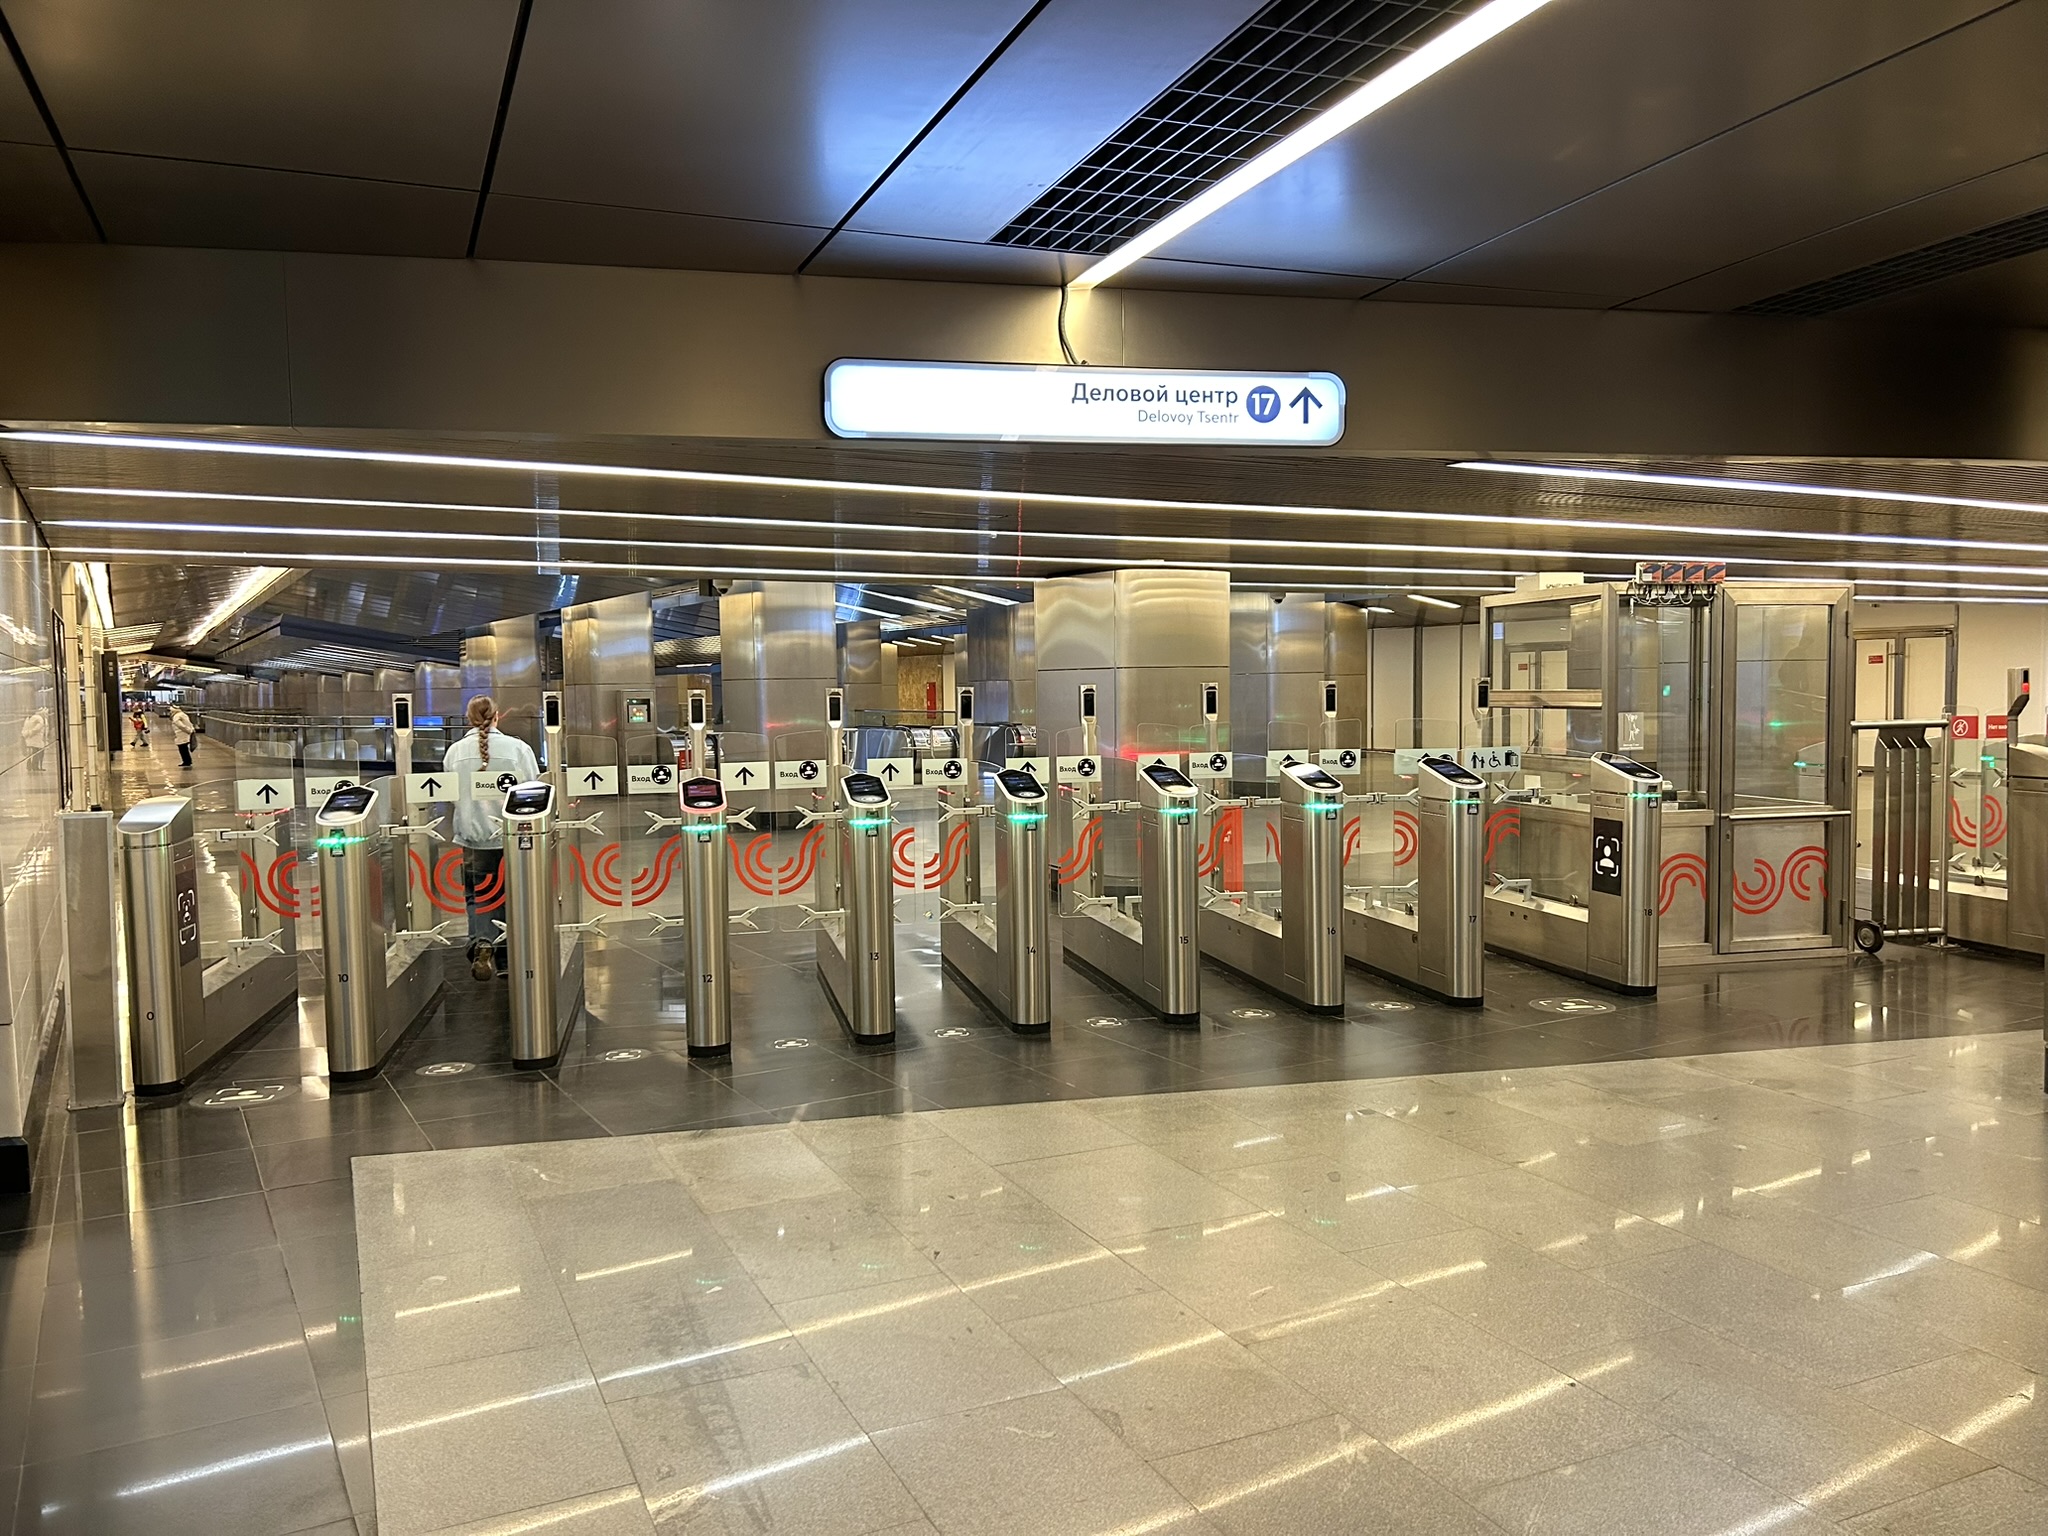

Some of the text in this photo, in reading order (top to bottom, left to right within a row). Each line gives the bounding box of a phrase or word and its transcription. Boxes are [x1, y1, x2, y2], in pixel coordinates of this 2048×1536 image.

[1072, 383, 1238, 408] Деловой центр
[1251, 393, 1276, 416] 17
[1138, 410, 1239, 425] Delovoy Tsentr
[1192, 762, 1209, 770] Вход
[1322, 758, 1338, 766] Вход
[925, 769, 943, 777] Вход
[1059, 765, 1076, 773] Вход
[631, 775, 650, 783] Вход
[780, 771, 798, 779] Вход
[475, 781, 495, 790] Вход
[1644, 908, 1653, 917] 18
[1468, 915, 1478, 925] 17
[1327, 926, 1337, 936] 16
[1179, 936, 1189, 945] 15
[1026, 946, 1037, 955] 14
[869, 951, 880, 961] 13
[337, 974, 350, 984] 10
[525, 970, 535, 980] 11
[702, 973, 714, 984] 12
